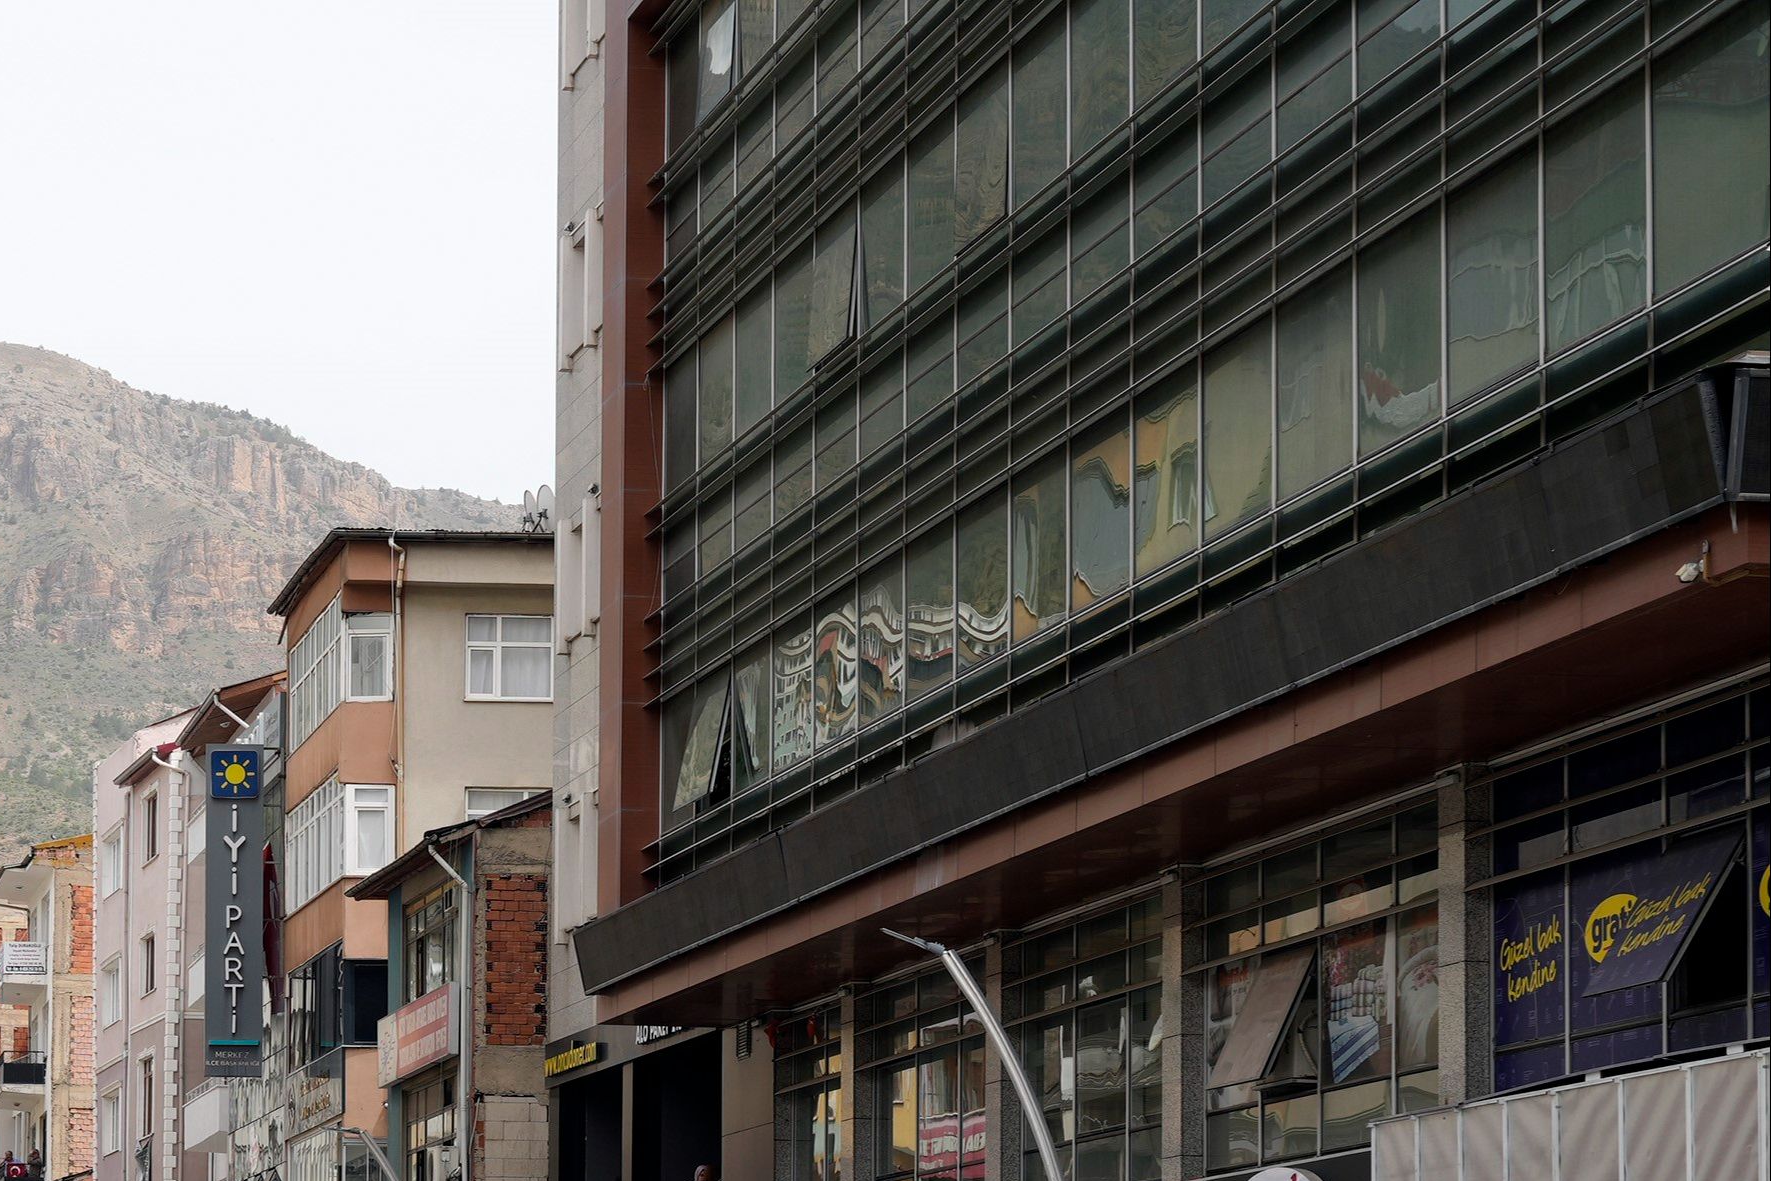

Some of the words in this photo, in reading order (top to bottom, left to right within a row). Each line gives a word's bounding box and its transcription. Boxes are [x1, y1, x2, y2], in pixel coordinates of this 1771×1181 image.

[1676, 871, 1712, 910] bak
[1500, 930, 1534, 971] Güzel
[1538, 914, 1563, 954] bak
[1617, 913, 1687, 958] kendine
[223, 905, 245, 1034] PARTİ
[1507, 959, 1557, 1003] kendine
